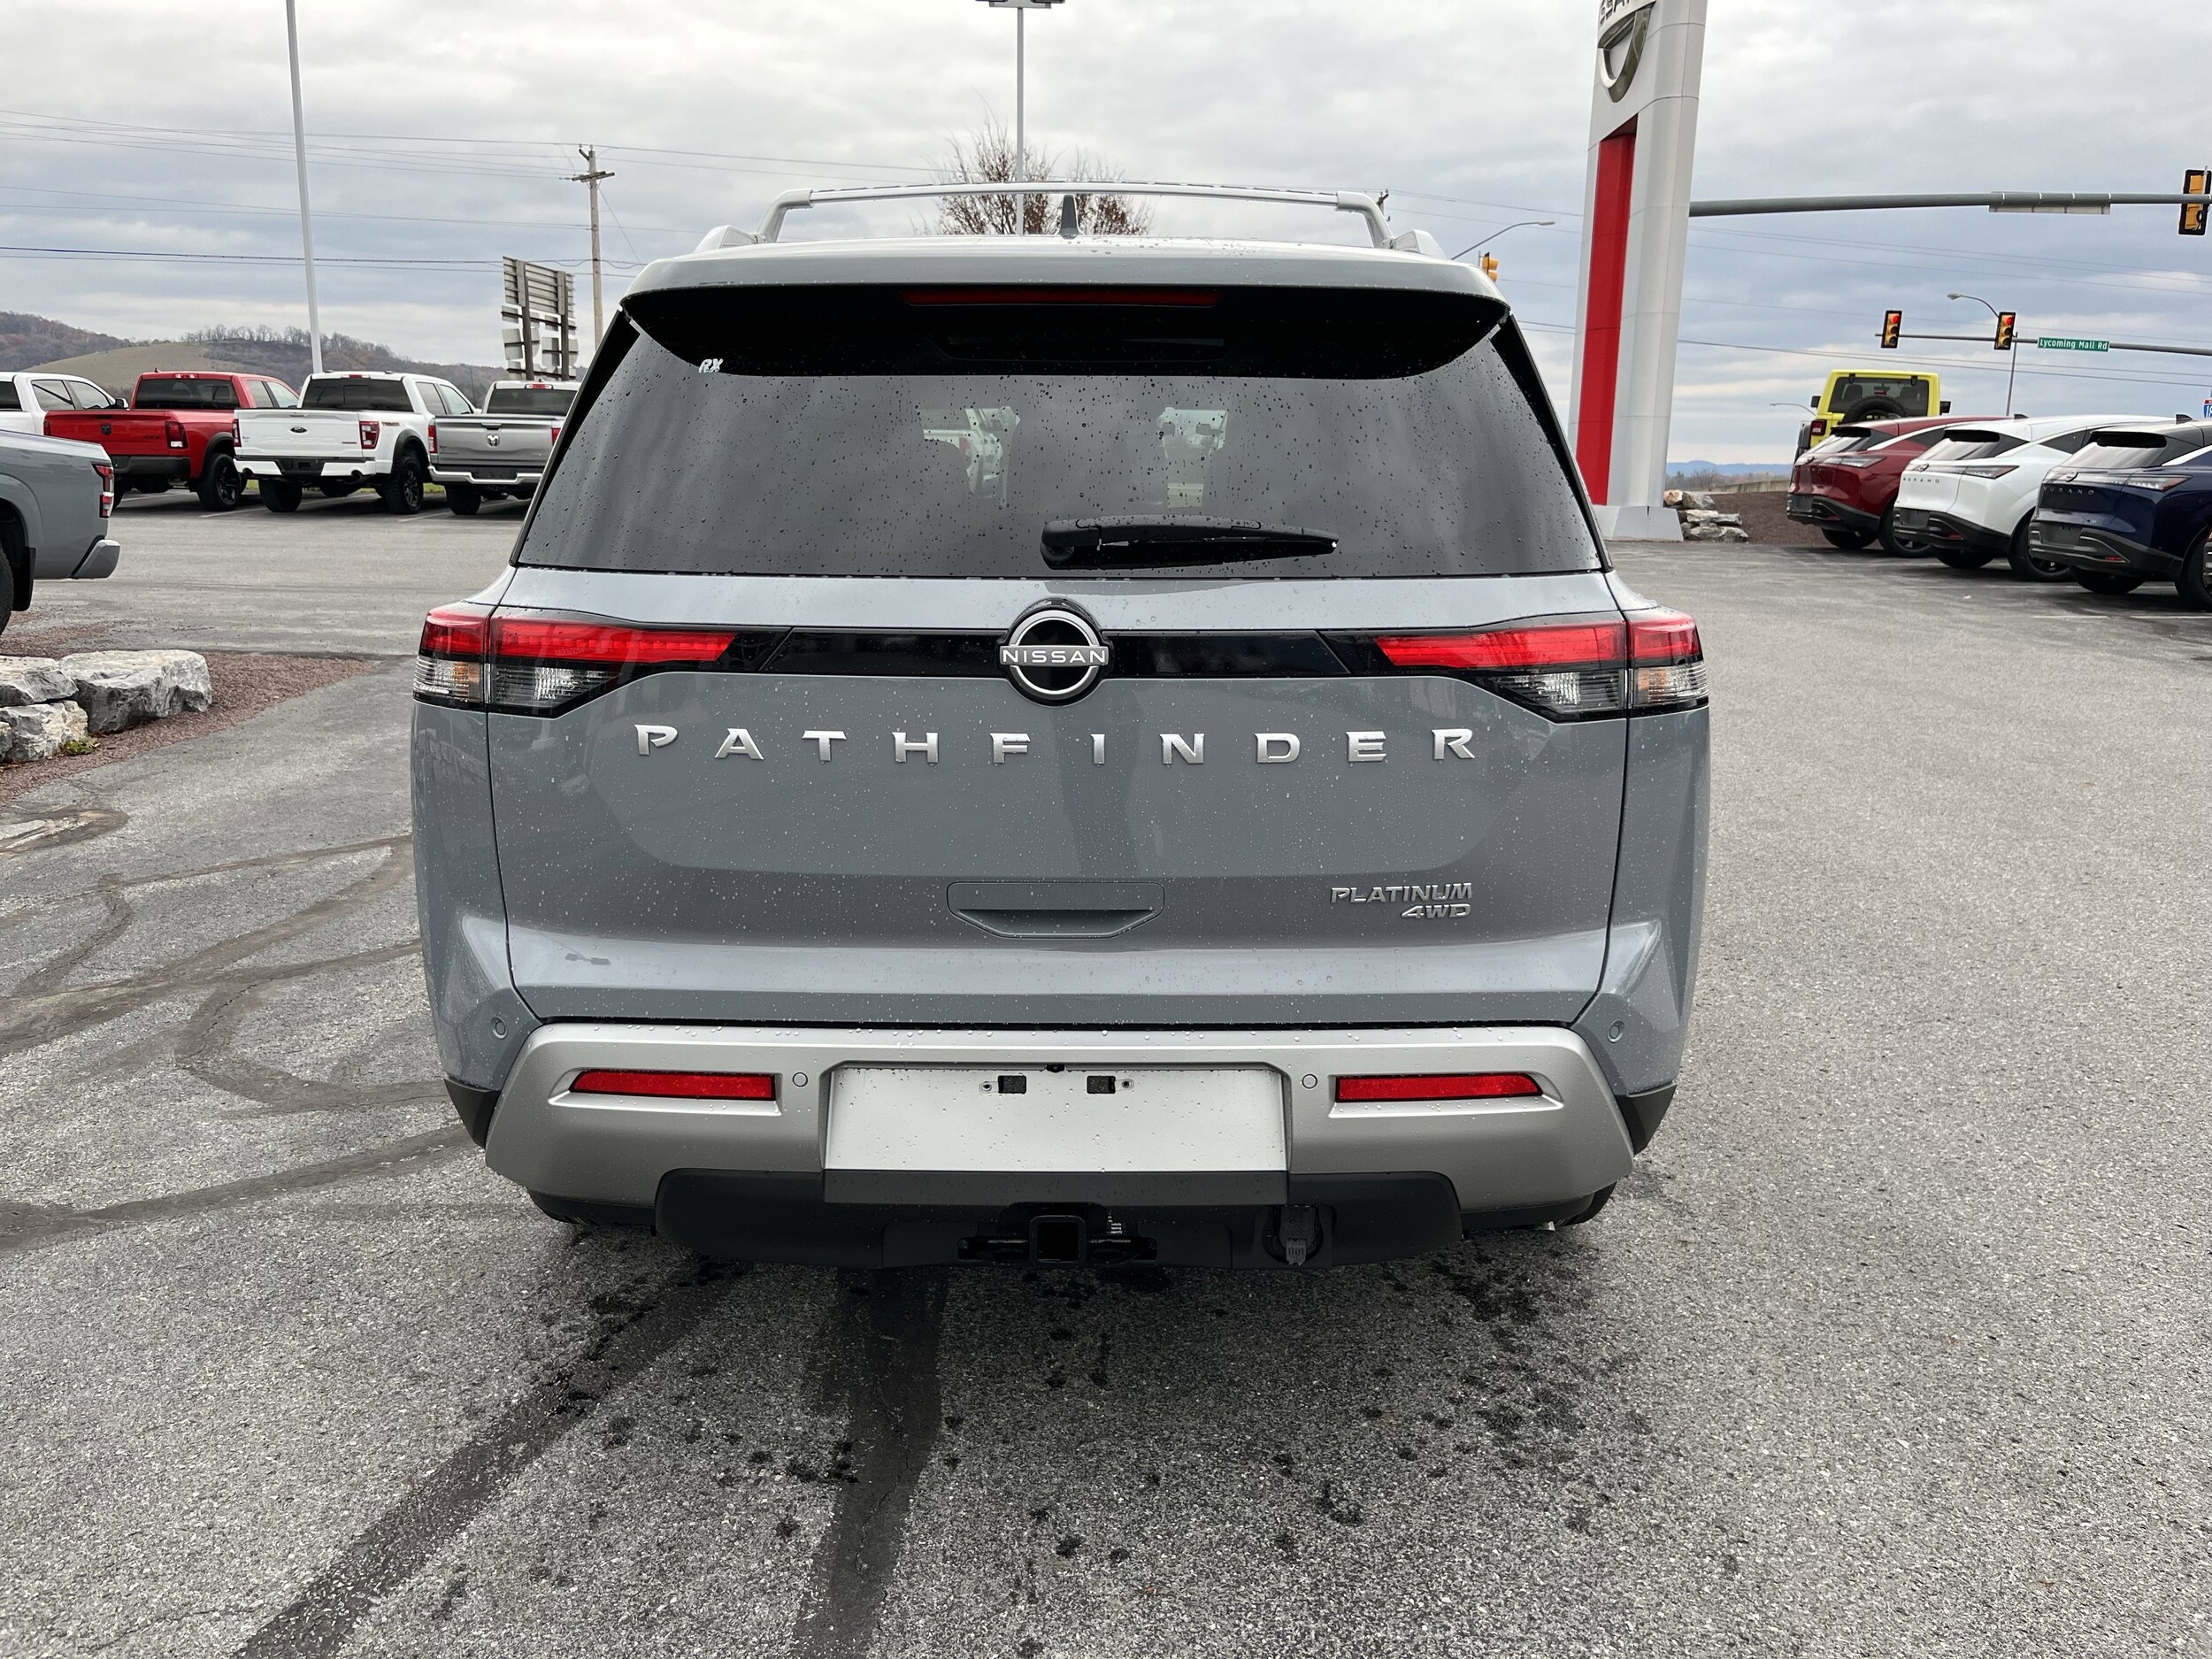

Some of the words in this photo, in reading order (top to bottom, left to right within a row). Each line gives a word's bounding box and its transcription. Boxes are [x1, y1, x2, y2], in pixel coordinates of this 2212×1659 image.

[2039, 338, 2076, 349] Lycoming
[2078, 340, 2095, 349] Mall
[2097, 342, 2108, 350] Rd
[1002, 649, 1106, 664] NISSAN
[634, 724, 1476, 765] PATHFINDER
[1330, 882, 1472, 903] PLATINUM
[1401, 902, 1471, 919] 4WD
